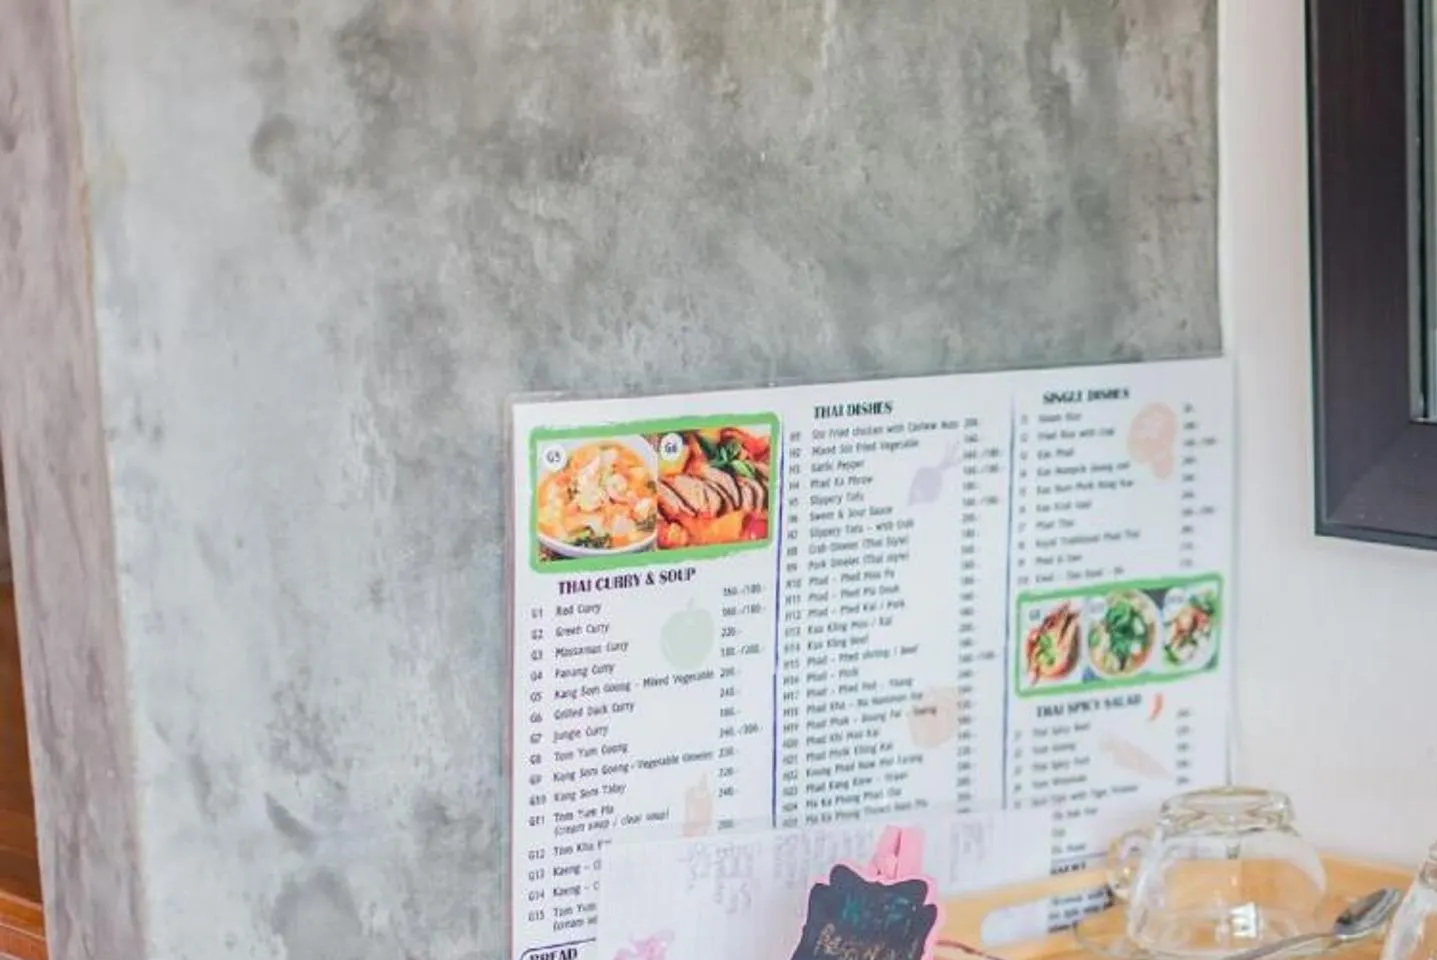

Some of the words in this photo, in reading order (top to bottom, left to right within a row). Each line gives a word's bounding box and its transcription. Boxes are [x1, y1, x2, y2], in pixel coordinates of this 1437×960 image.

[814, 406, 844, 419] THAI
[847, 401, 894, 416] DISHES
[558, 580, 592, 595] THAI
[595, 576, 641, 592] CURRY
[659, 568, 696, 583] SOUP
[556, 606, 574, 616] Red
[578, 604, 601, 614] Curry
[555, 627, 582, 637] Green
[586, 624, 610, 634] Curry
[607, 642, 629, 653] Curry
[555, 667, 588, 679] Panang
[592, 664, 615, 675] Curry
[587, 705, 608, 717] Duck
[612, 702, 635, 713] Curry
[586, 726, 609, 737] Curry
[554, 751, 574, 761] Tom
[578, 749, 597, 759] Yum
[554, 812, 573, 822] Tom
[601, 806, 614, 816] Pla
